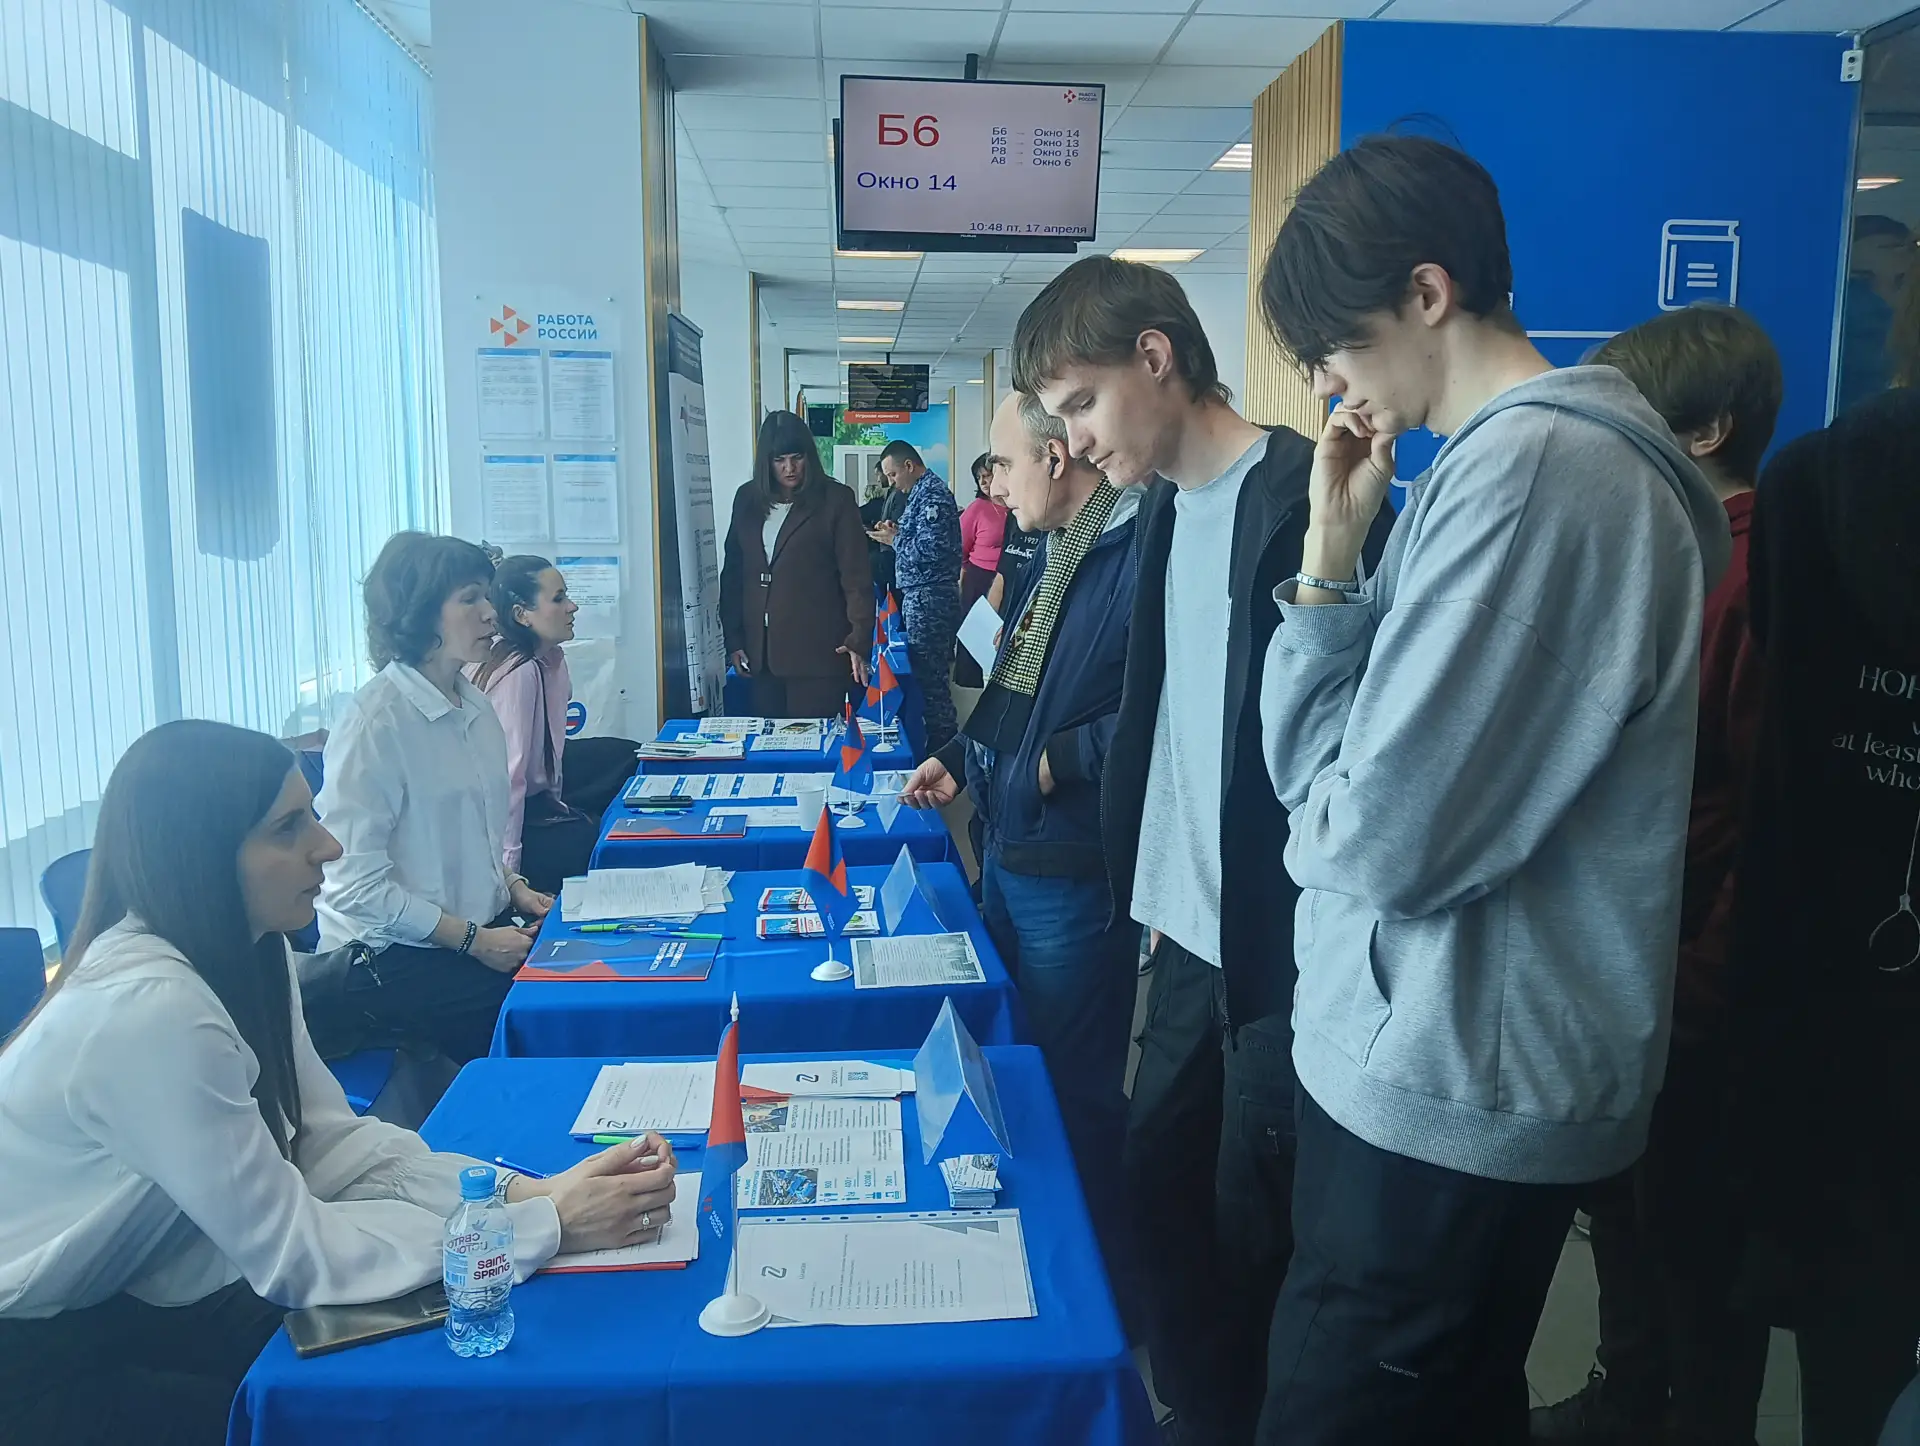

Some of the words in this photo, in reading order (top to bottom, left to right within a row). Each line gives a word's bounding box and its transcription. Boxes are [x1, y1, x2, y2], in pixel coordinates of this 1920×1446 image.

[878, 114, 940, 147] Б6
[992, 126, 1007, 136] Б6
[1034, 128, 1063, 137] Окно
[1066, 129, 1080, 138] 14
[991, 136, 1007, 145] И5
[1033, 138, 1062, 147] Окно
[1065, 139, 1080, 148] 13
[991, 146, 1007, 155] Р8
[1033, 147, 1062, 157] Окно
[1065, 149, 1079, 158] 16
[990, 156, 1006, 165] А8
[1032, 157, 1061, 167] Окно
[1064, 158, 1072, 167] 6
[857, 171, 920, 190] Окно
[928, 174, 958, 191] 14
[969, 222, 1003, 232] 10:48
[1006, 224, 1021, 233] пт,
[1026, 224, 1040, 233] 17
[1043, 225, 1087, 234] апреля
[537, 314, 594, 326] РАБОТА
[537, 328, 598, 340] РОССИИ
